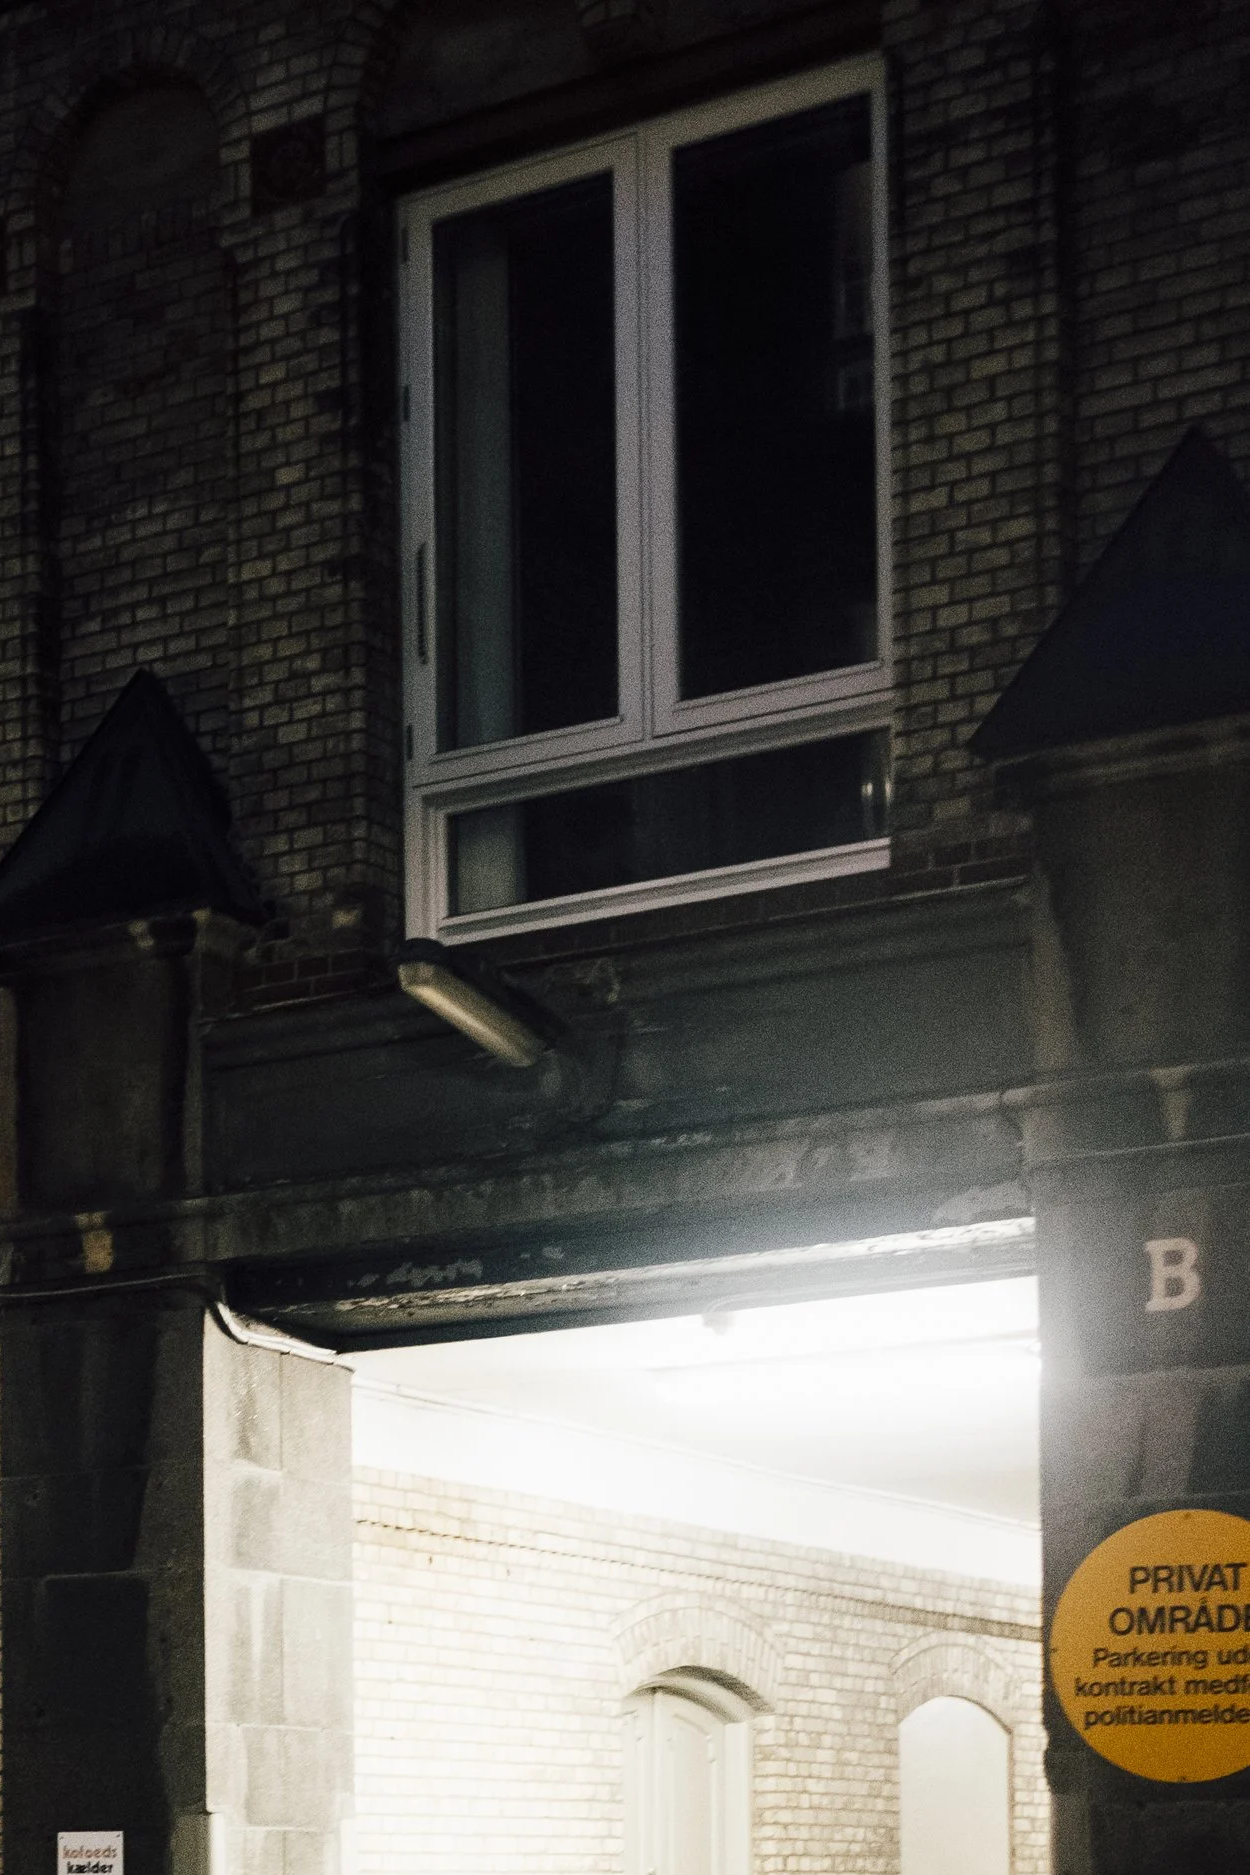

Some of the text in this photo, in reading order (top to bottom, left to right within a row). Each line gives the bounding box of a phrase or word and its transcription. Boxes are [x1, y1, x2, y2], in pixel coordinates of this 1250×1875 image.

[1145, 1237, 1200, 1312] B
[1129, 1563, 1247, 1594] PRIVAT
[1093, 1644, 1250, 1669] Parkering ud
[1074, 1676, 1176, 1697] kontrakt
